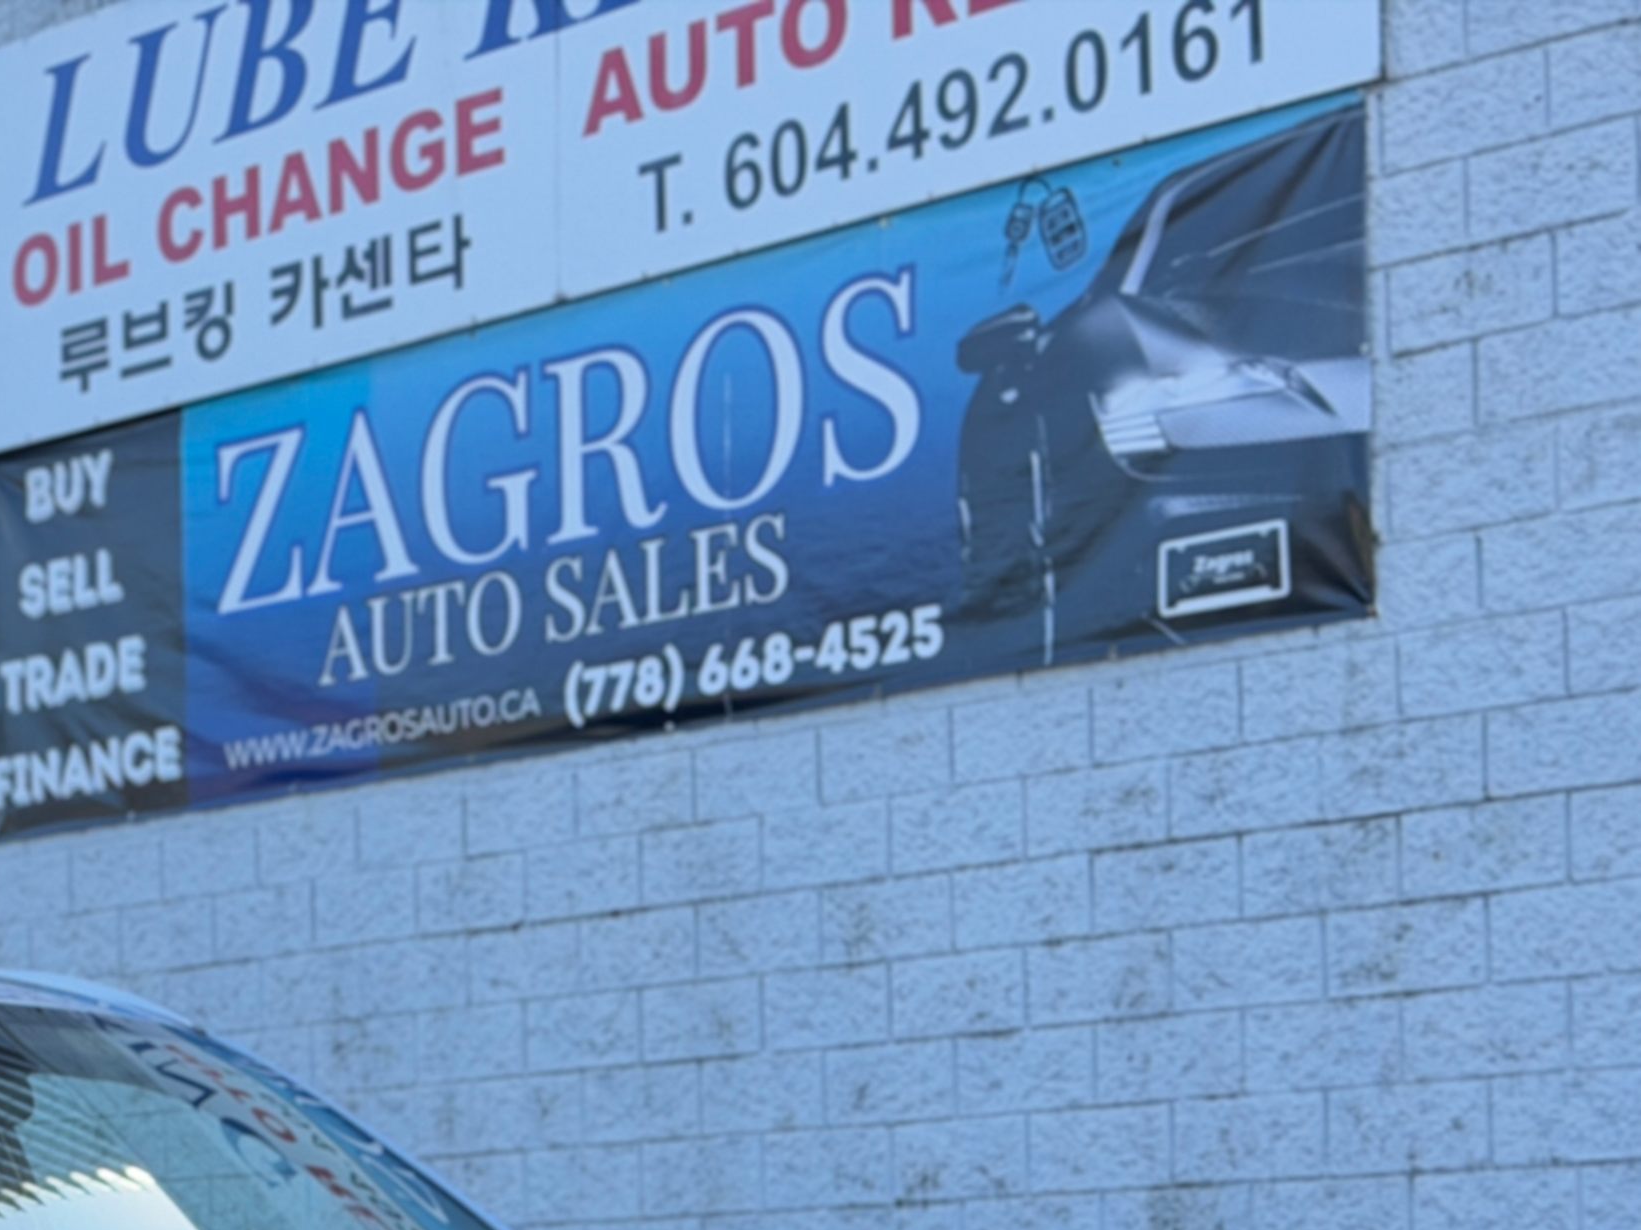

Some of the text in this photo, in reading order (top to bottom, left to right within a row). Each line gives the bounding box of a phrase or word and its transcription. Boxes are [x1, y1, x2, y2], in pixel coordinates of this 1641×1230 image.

[21, 0, 417, 206] LUBE
[583, 0, 846, 136] AUTO
[639, 154, 693, 232] T.
[723, 0, 1266, 208] 604.492.0161
[13, 87, 505, 306] OIL CHANGE
[60, 214, 471, 392] 루브킹 카센타
[25, 449, 113, 524] BUY
[216, 268, 921, 614] ZAGROS
[19, 548, 125, 618] SELL
[318, 513, 788, 687] AUTO SALES
[0, 635, 147, 714] TRADE
[223, 687, 541, 771] WWW.ZAGROSAUTO.CA
[564, 604, 945, 728] (778) 668-4525
